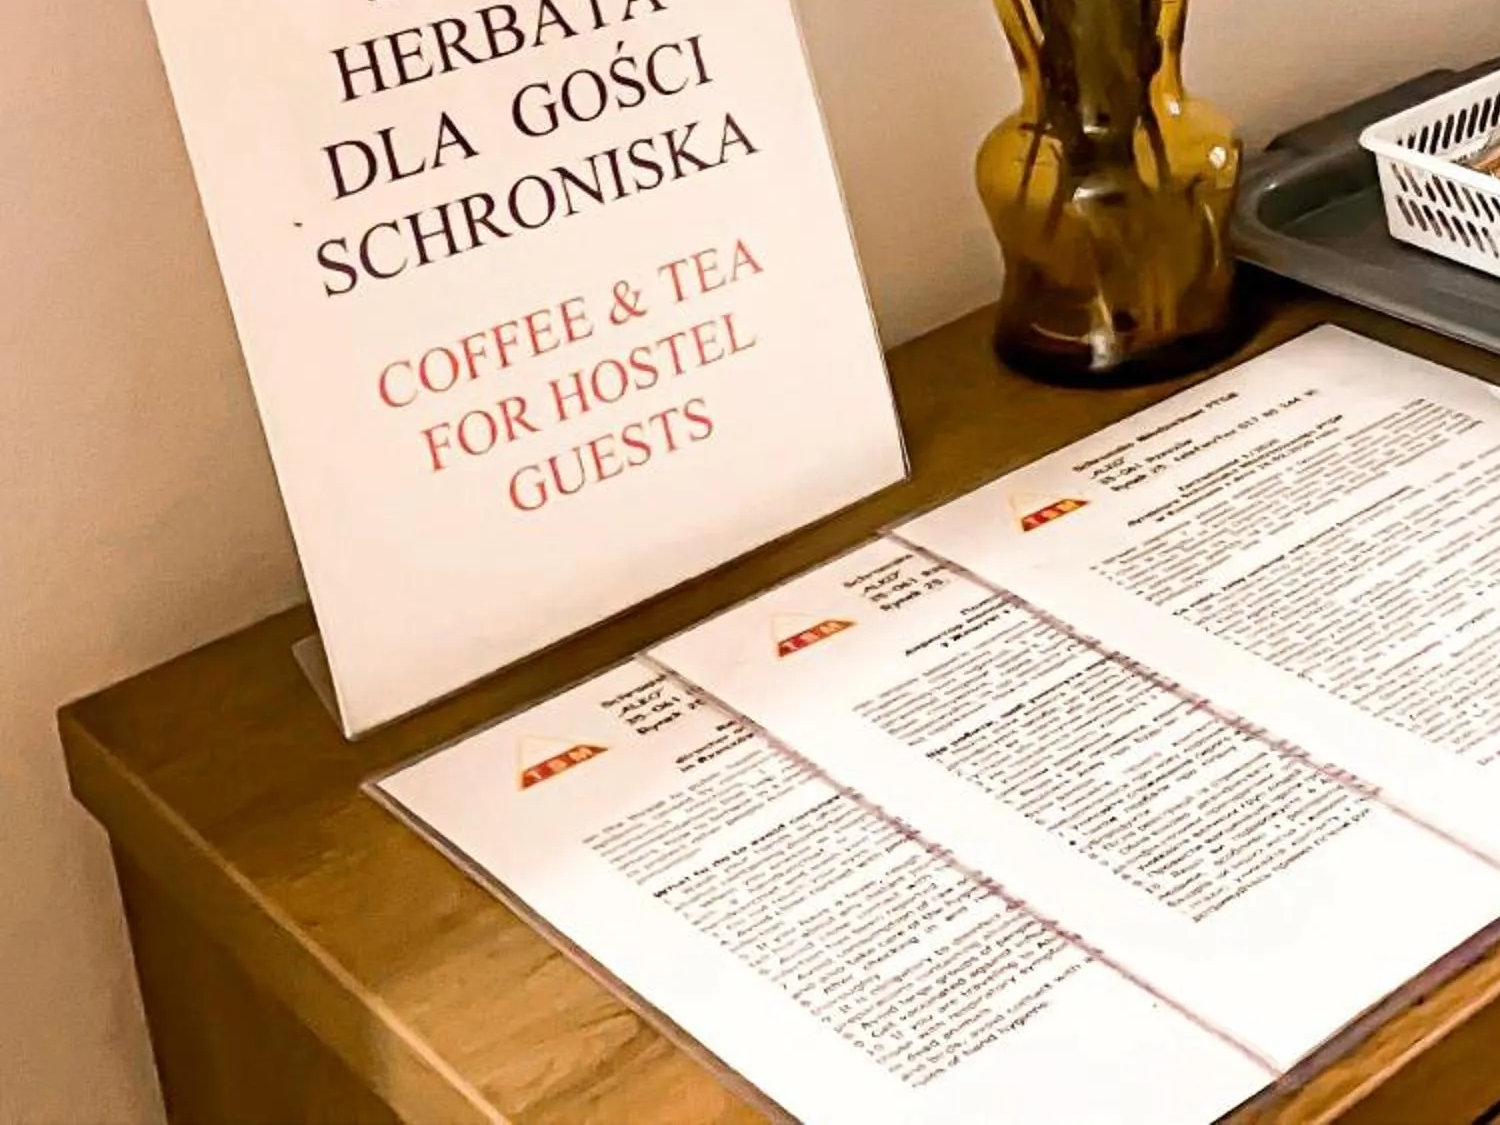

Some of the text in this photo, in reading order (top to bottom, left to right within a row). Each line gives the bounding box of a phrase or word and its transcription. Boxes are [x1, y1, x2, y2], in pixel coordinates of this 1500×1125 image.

[323, 33, 714, 200] DLA GOŚCI
[316, 111, 760, 298] SCHRONISKA
[378, 237, 765, 408] COFFEE & TEA
[420, 312, 758, 473] FOR HOSTEL
[508, 396, 714, 512] GUESTS
